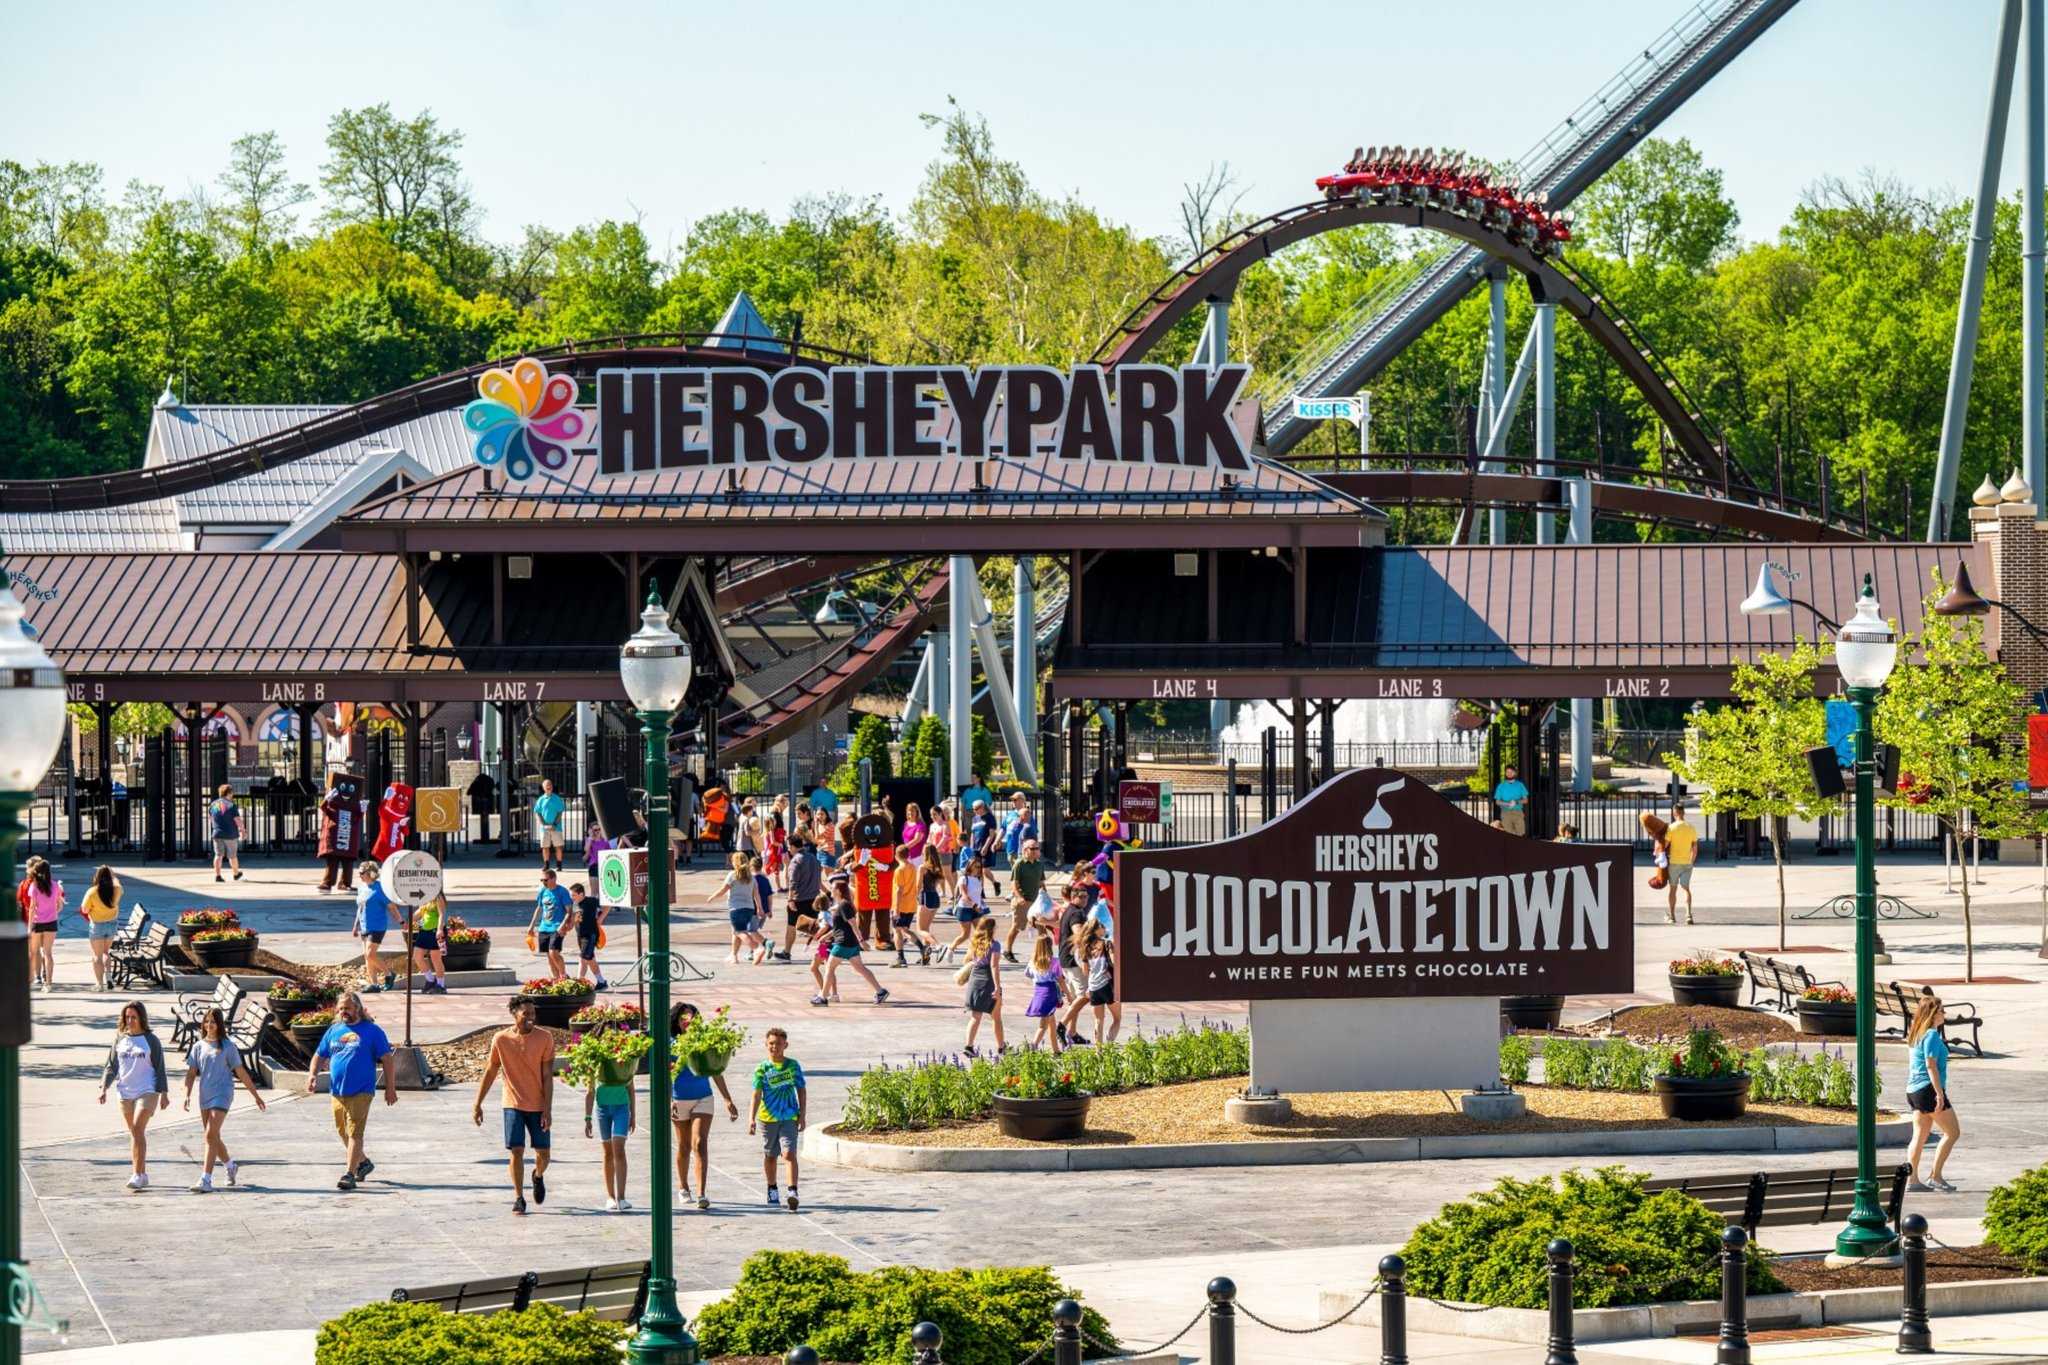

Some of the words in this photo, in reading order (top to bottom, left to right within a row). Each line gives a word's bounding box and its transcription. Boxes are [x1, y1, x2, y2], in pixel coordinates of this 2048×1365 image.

[598, 366, 1253, 477] HERSHEYPARK
[9, 571, 58, 601] HERSHEY
[64, 683, 85, 701] NE
[94, 683, 104, 701] 9
[262, 683, 305, 701] LANE
[315, 683, 325, 701] 8
[483, 682, 527, 700] LANE
[536, 682, 545, 700] 7
[1152, 679, 1196, 698] LANE
[1206, 679, 1217, 698] 4
[1379, 679, 1422, 697] LANE
[1432, 679, 1442, 697] 3
[1605, 678, 1650, 697] LANE
[1660, 679, 1670, 697] 2
[1315, 833, 1438, 872] HERSHEY'S
[1141, 860, 1612, 957] CHOCOLATETOWN
[1227, 966, 1293, 980] WHERE
[1301, 965, 1338, 979] FUN
[1347, 964, 1407, 978] MEETS
[1415, 962, 1528, 977] CHOCOLATE
